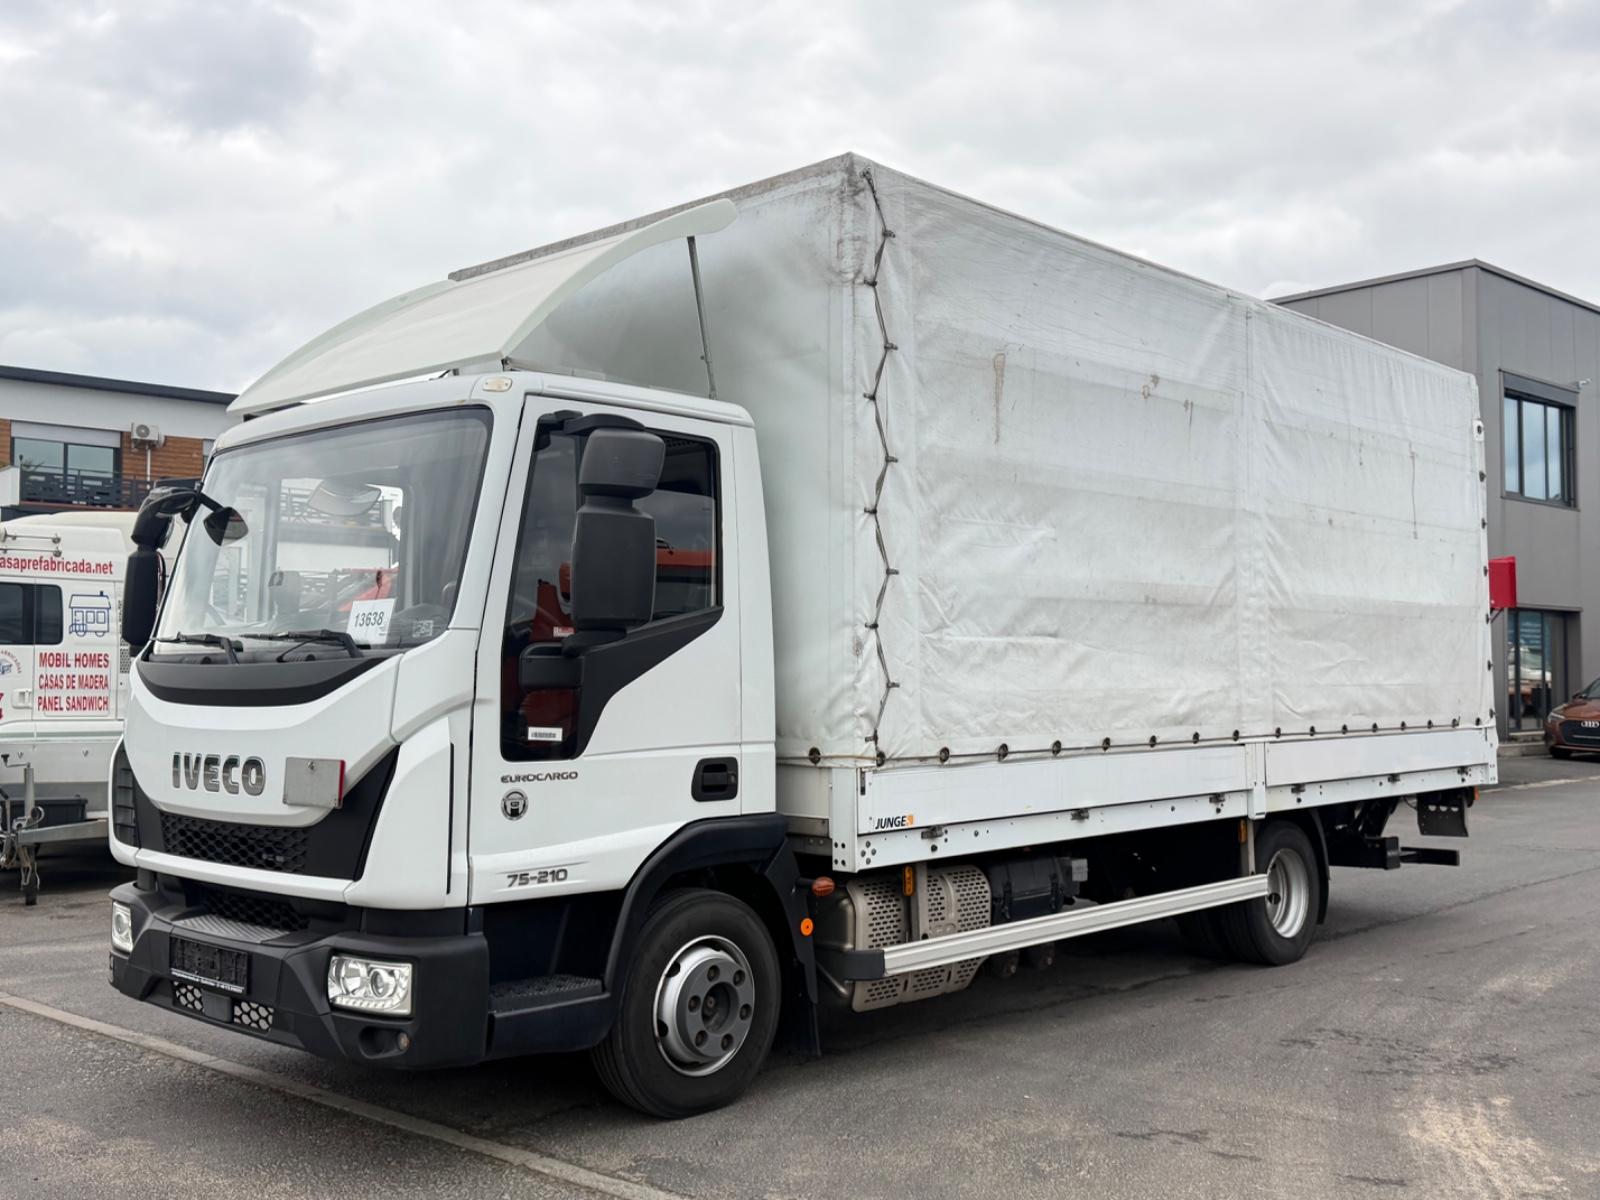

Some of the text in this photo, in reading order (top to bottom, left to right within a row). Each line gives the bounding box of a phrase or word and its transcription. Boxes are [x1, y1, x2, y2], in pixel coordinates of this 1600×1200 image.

[354, 611, 385, 628] 13638
[39, 652, 71, 668] MOBIL
[74, 653, 110, 668] HOMES
[39, 674, 109, 690] CASAS DE MADERA
[37, 696, 109, 711] PANEL SANDWICH
[172, 752, 267, 797] IVECO
[500, 771, 579, 783] EUROCARGO
[875, 815, 907, 830] JUNGE
[507, 868, 568, 888] 75-210
